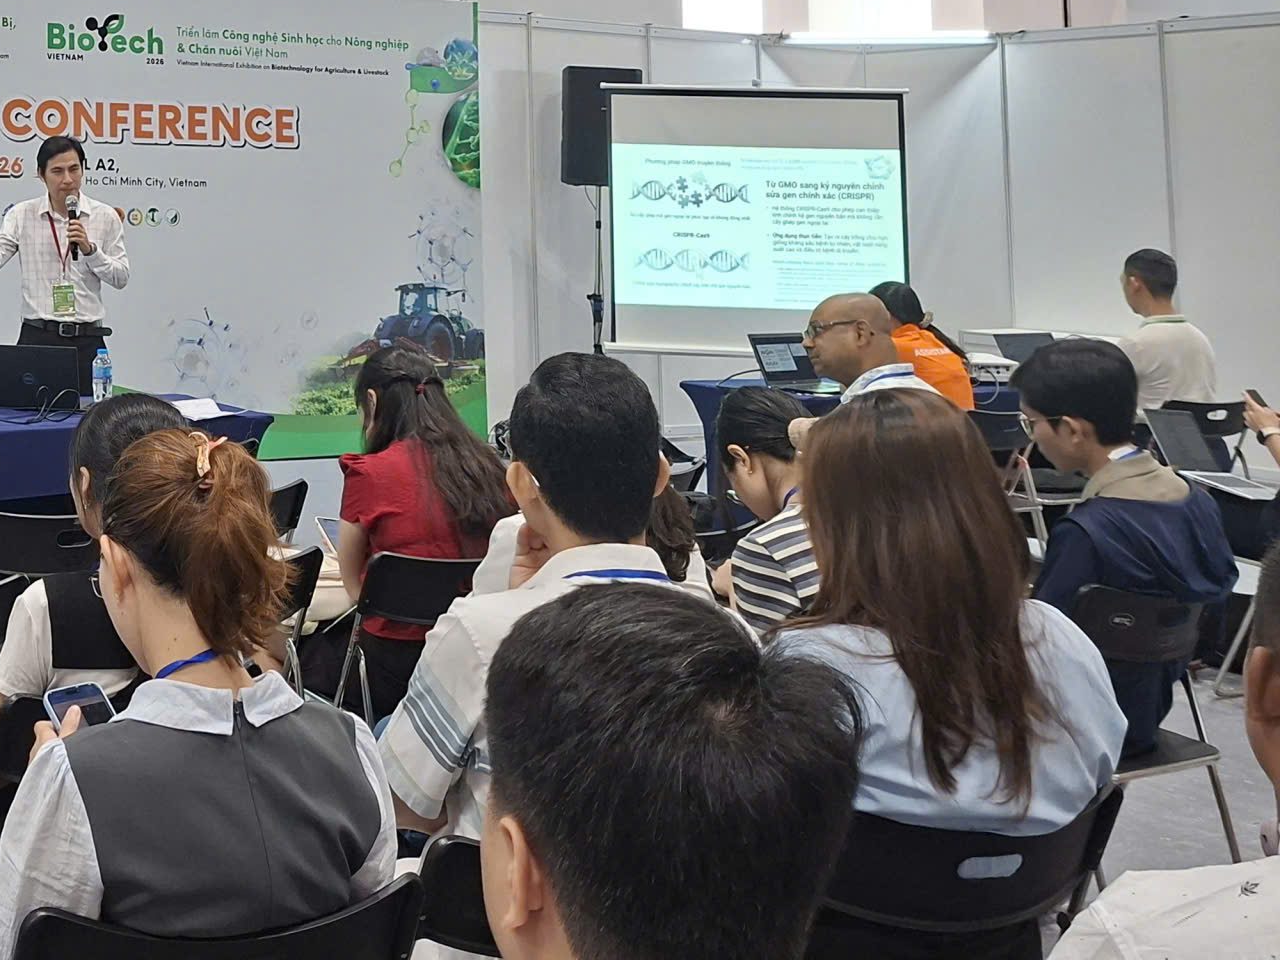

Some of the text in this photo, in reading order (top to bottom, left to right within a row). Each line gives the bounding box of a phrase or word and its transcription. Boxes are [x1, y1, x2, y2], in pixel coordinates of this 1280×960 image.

[2, 17, 16, 30] Bị,
[177, 26, 409, 52] Triển lãm Công nghệ Sinh học cho Nông nghiệp
[177, 43, 288, 58] & Chăn nuôi Việt Nam
[272, 64, 313, 73] Biotechnology
[1, 97, 296, 144] CONFERENCE
[96, 159, 119, 173] A2,
[86, 177, 207, 188] Ho Chi Minh City, Vietnam
[800, 182, 818, 190] sang
